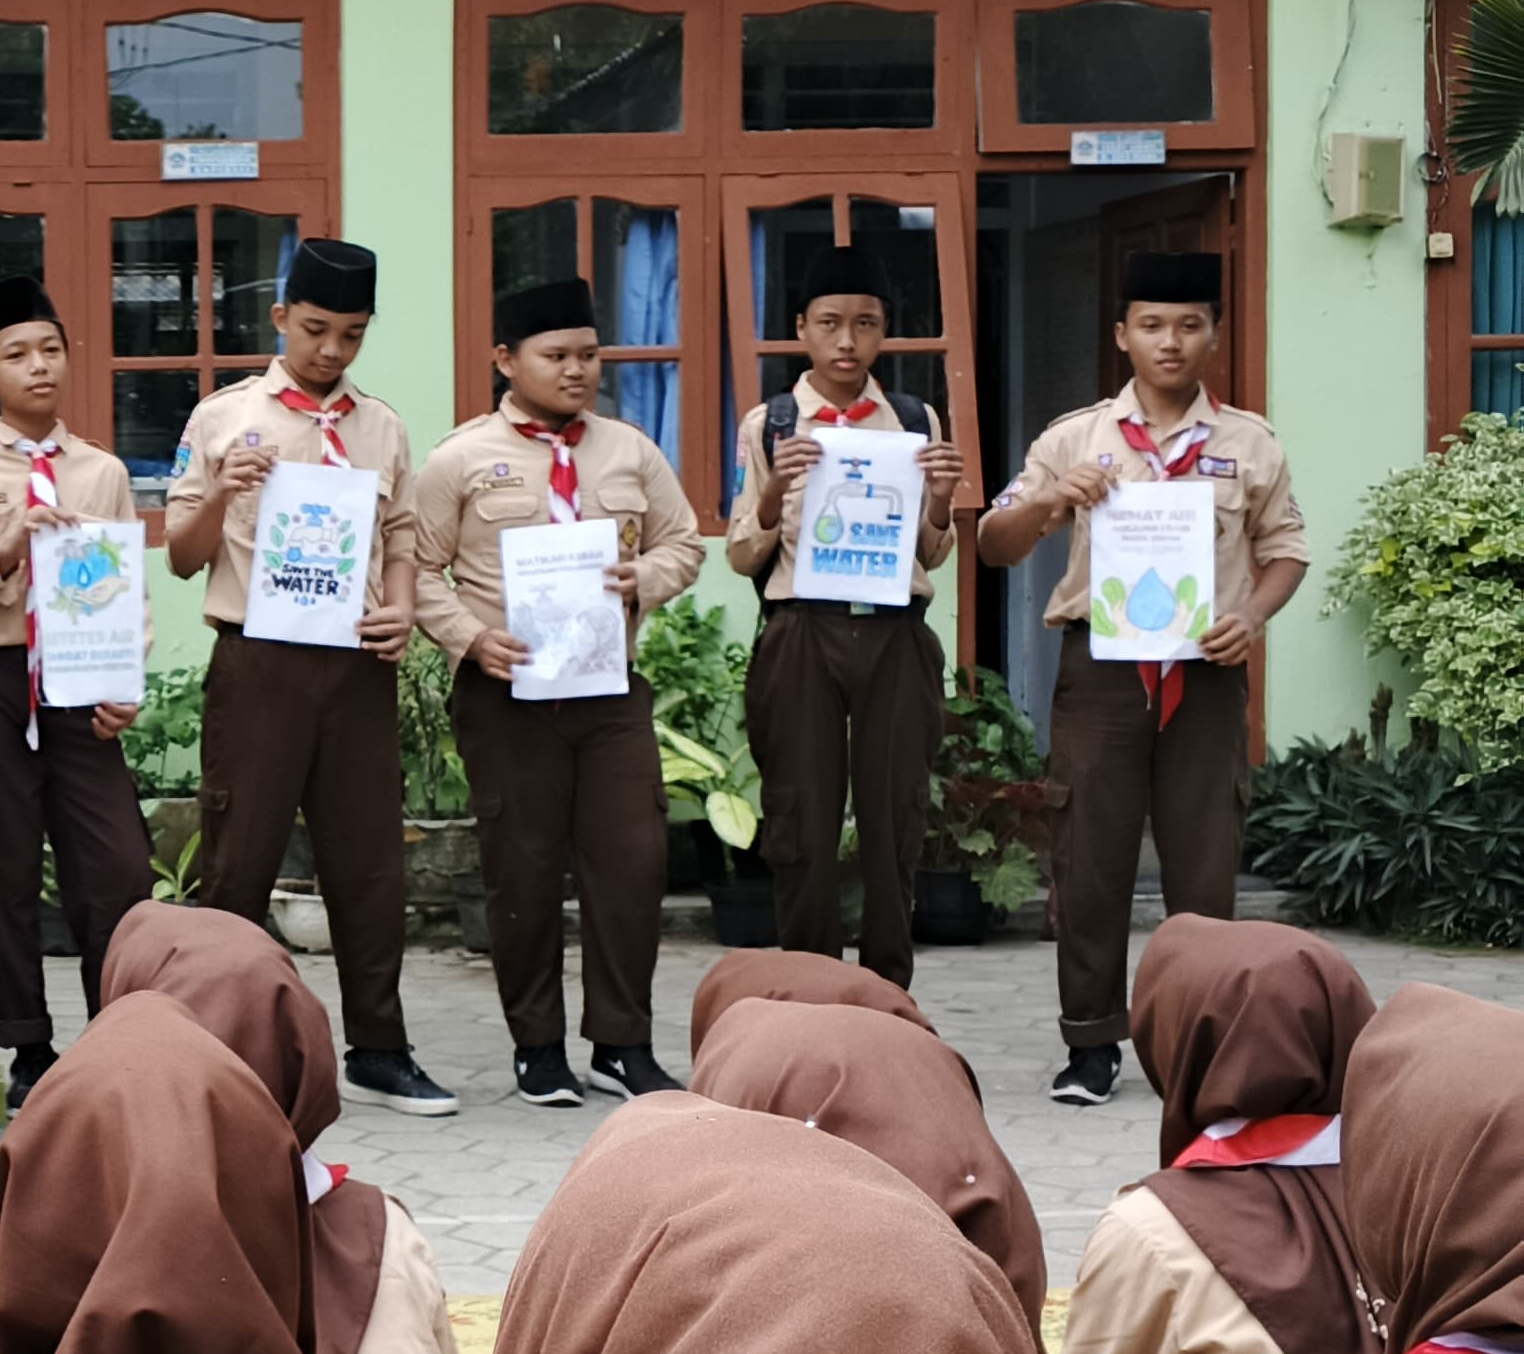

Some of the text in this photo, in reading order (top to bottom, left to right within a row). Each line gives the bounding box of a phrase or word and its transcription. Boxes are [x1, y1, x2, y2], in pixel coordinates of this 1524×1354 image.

[849, 522, 900, 547] SAVE
[313, 567, 335, 578] THE
[811, 546, 898, 578] WATER
[271, 573, 340, 596] WATER
